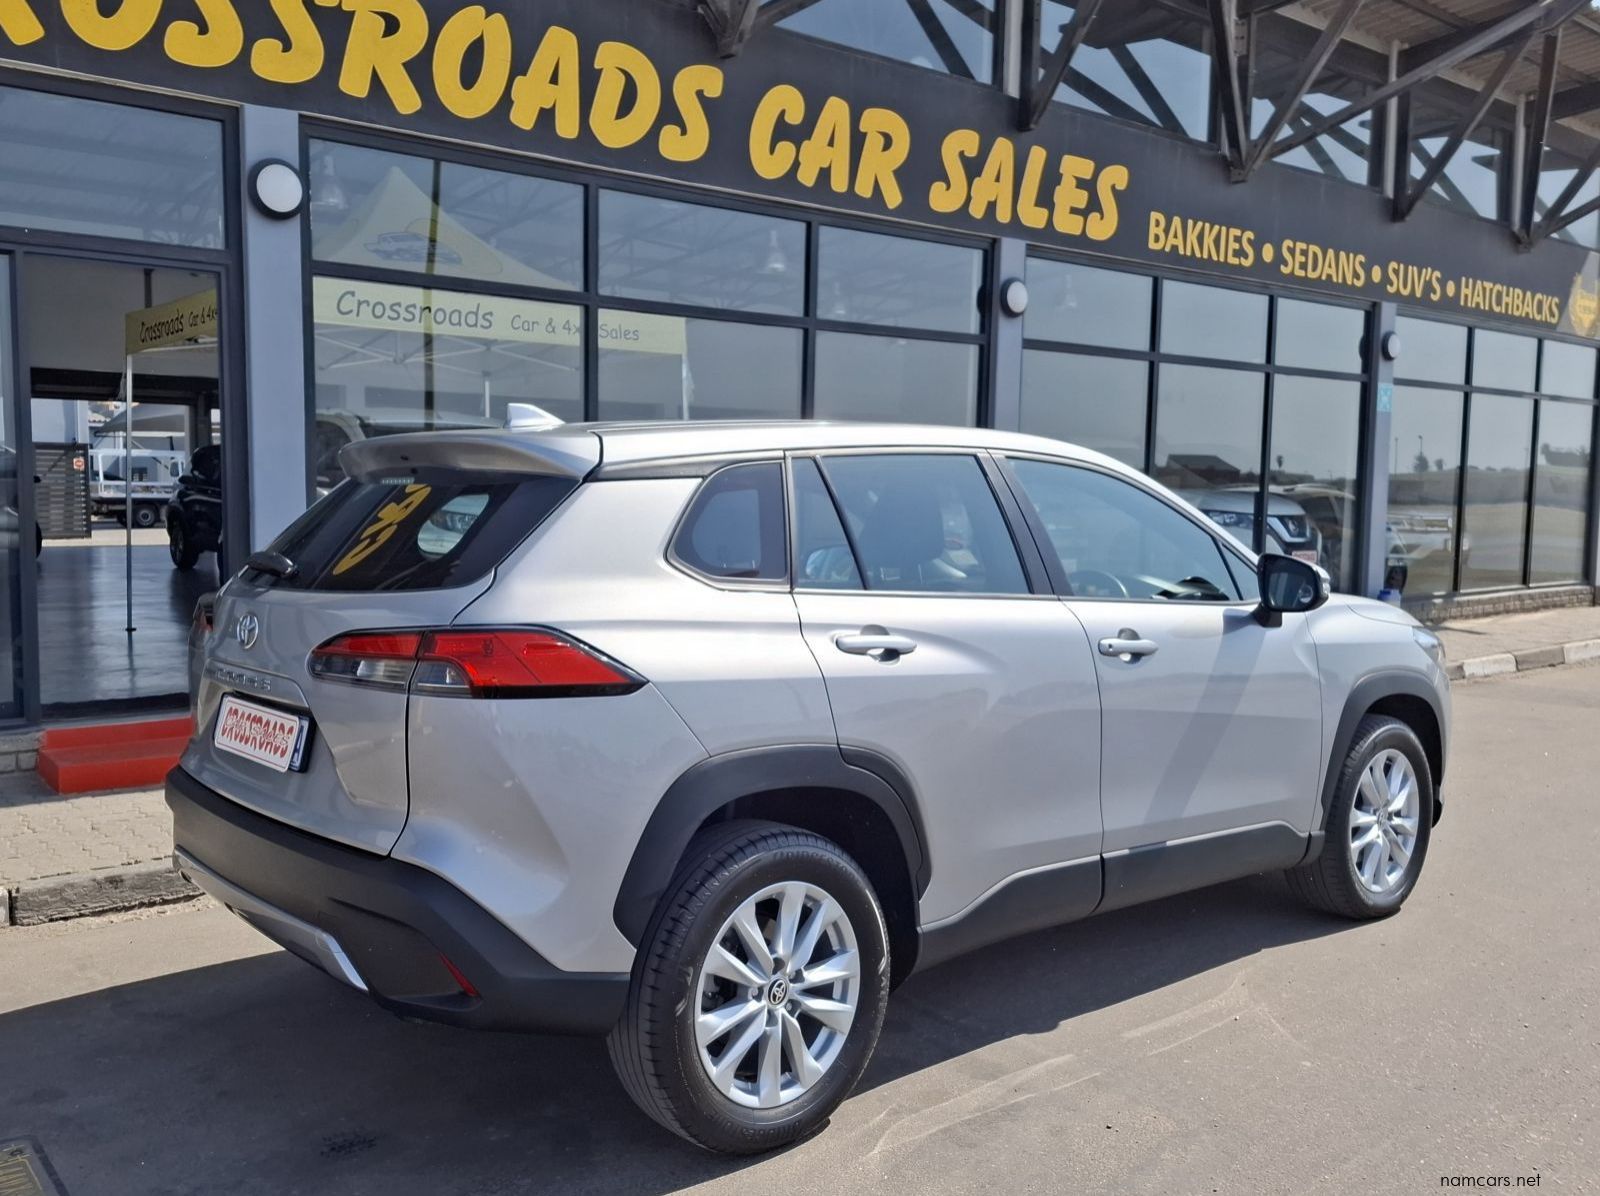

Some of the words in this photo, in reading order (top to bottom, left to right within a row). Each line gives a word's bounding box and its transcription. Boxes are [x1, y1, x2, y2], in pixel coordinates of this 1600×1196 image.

[749, 84, 911, 210] CAR
[929, 129, 1130, 241] SALES
[1148, 211, 1255, 267] BAKKIES
[1280, 239, 1365, 288] SEDANS
[1386, 261, 1441, 301] SUV'S
[1460, 276, 1559, 324] HATCHBACKS
[140, 308, 184, 343] Crossroads
[336, 290, 493, 330] Crossroads
[510, 314, 540, 333] Car
[545, 317, 556, 334] &
[598, 323, 640, 341] Sales
